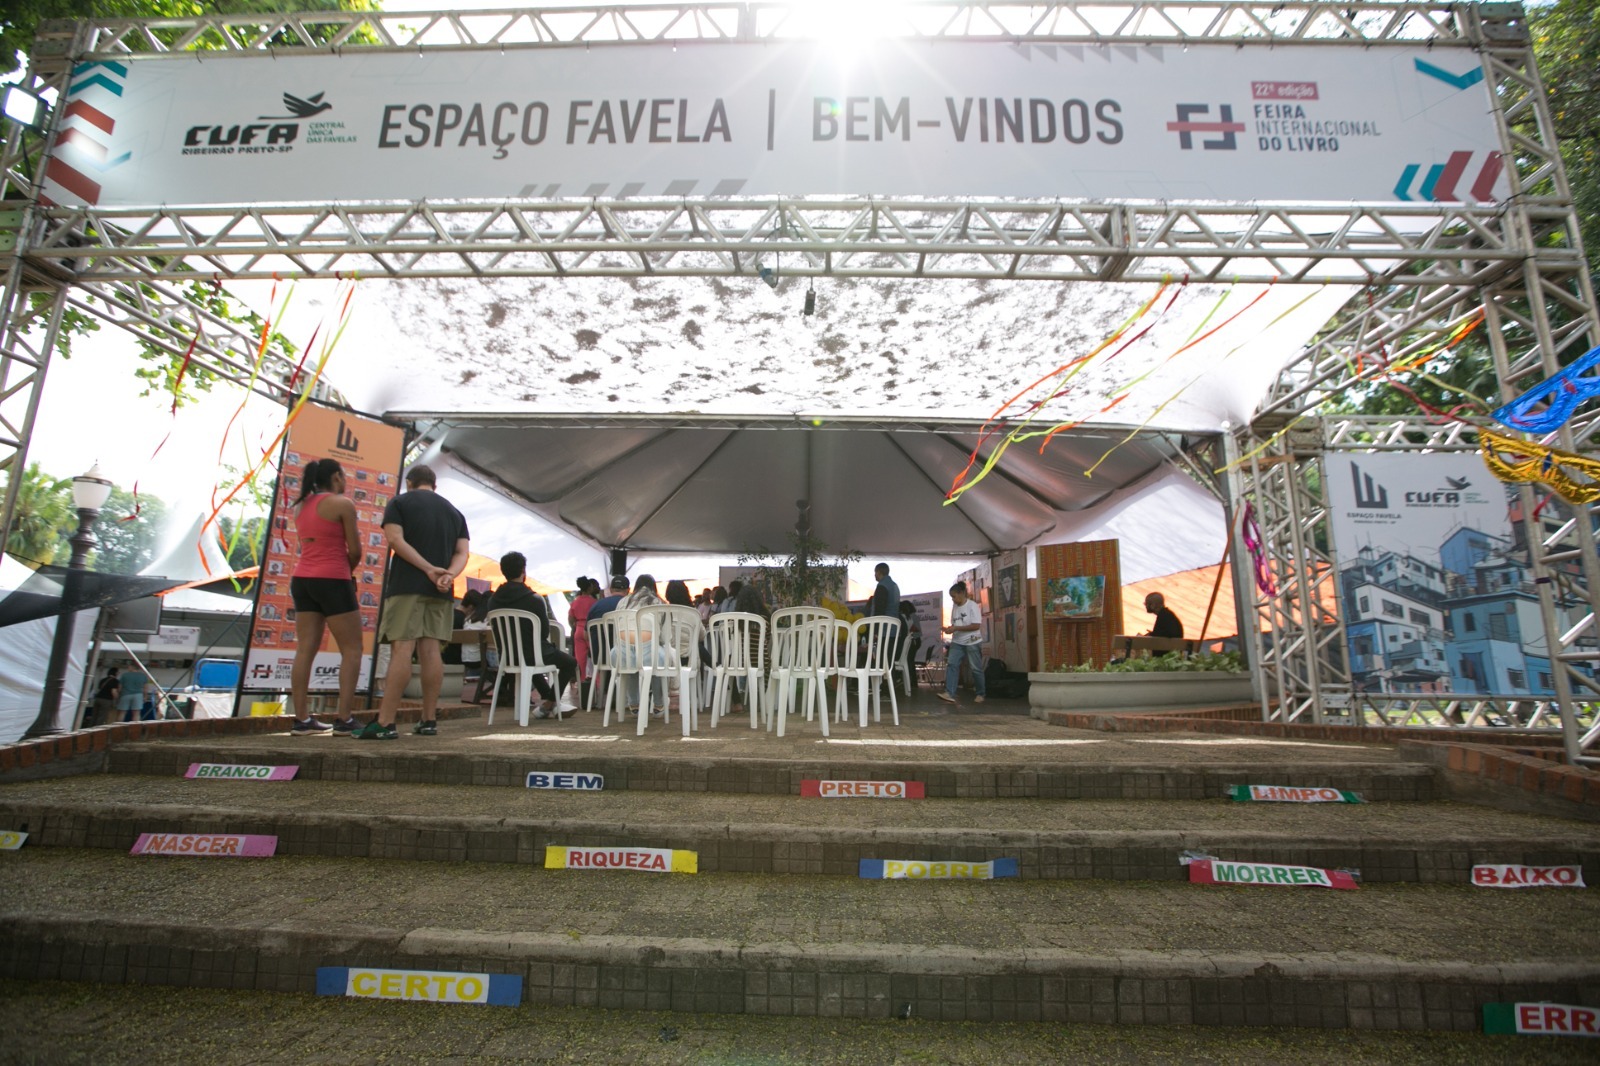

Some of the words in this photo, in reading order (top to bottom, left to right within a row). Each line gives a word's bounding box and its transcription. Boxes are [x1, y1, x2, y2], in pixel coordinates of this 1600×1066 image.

[1253, 104, 1306, 119] FEIRA
[308, 122, 345, 130] CENTRAL
[378, 101, 549, 160] ESPAÇO
[566, 98, 732, 145] FAVELA
[812, 96, 1124, 145] BEM-VINDOS
[1255, 120, 1382, 137] INTERNACIONAL
[184, 124, 300, 147] CUFA
[306, 136, 322, 144] DAS
[324, 135, 358, 144] FAVELAS
[181, 145, 235, 156] RIBEIRÃO
[1258, 136, 1282, 152] DO
[1287, 136, 1340, 152] LIVRO
[1404, 491, 1461, 504] CUFA
[315, 666, 342, 675] CUF
[196, 765, 271, 779] BRANCO
[528, 774, 603, 789] BEM
[821, 782, 903, 797] PRETO
[1252, 786, 1339, 801] LIMPO
[145, 834, 240, 855] NASCER
[569, 850, 666, 871] RIQUEZA
[886, 860, 990, 879] POBRE
[1216, 863, 1327, 885] MORRER
[1473, 866, 1577, 885] BAIXO
[352, 972, 484, 1001] CERTO
[1519, 1005, 1600, 1034] ERR
